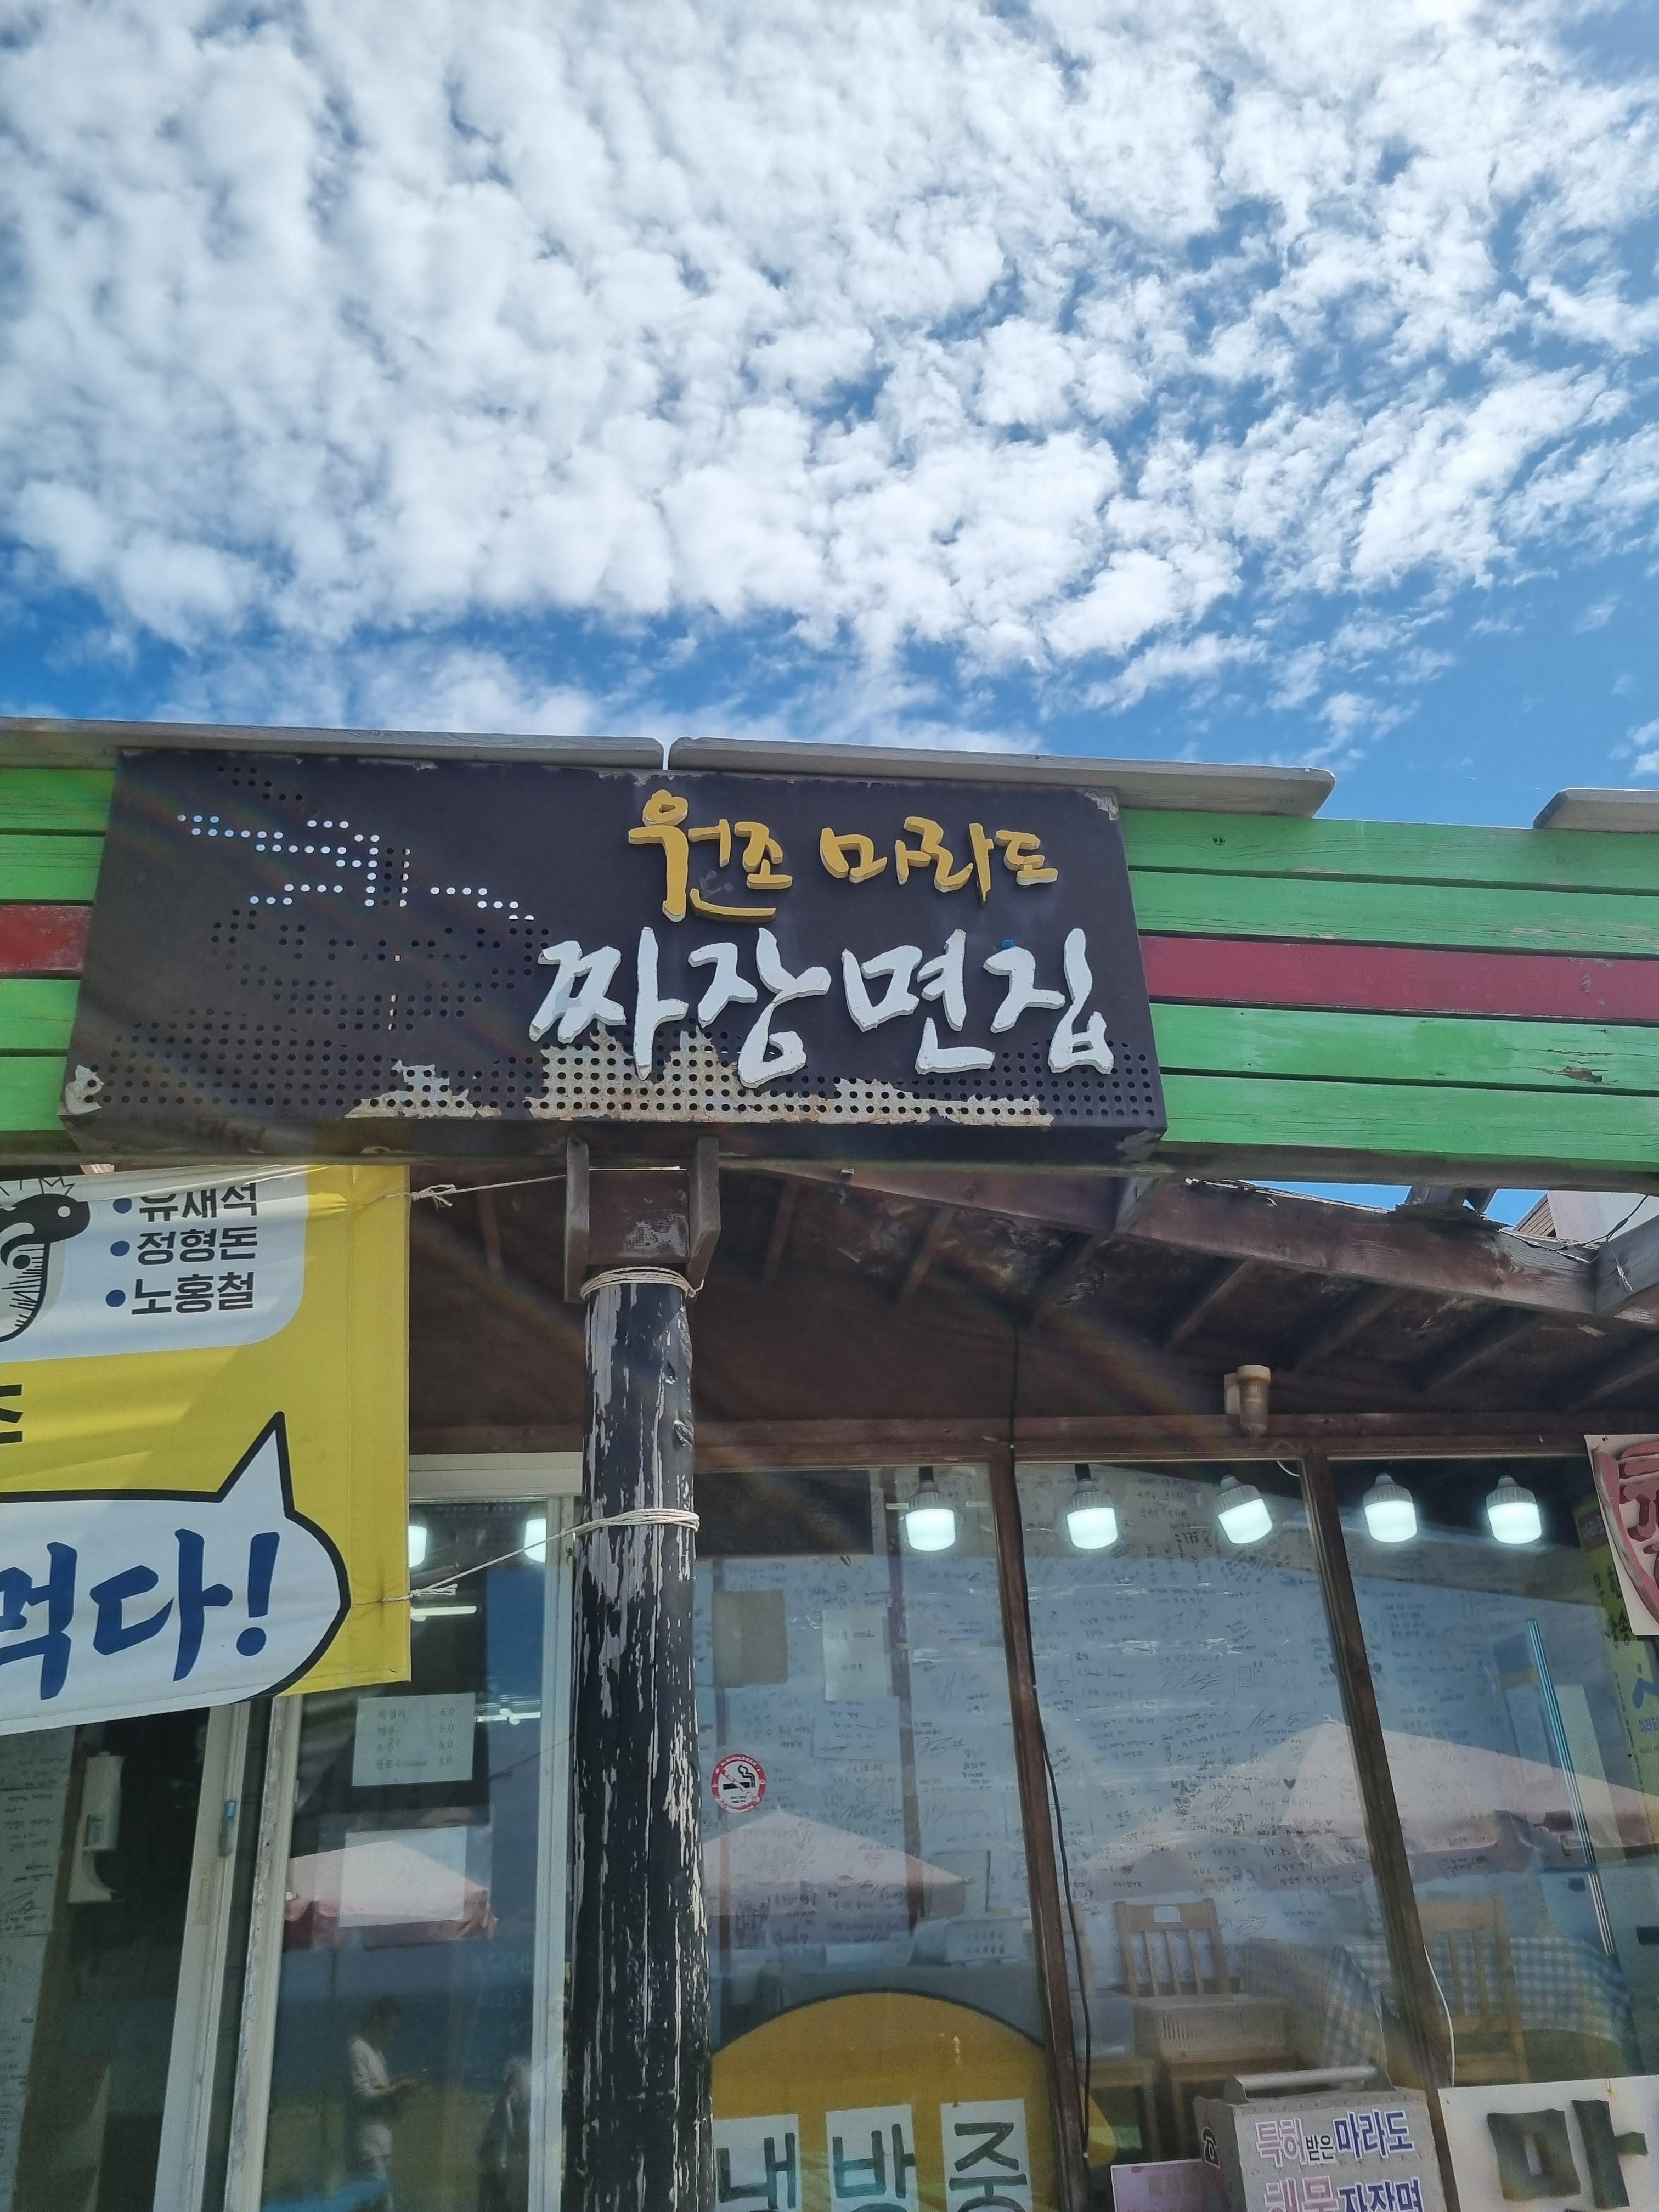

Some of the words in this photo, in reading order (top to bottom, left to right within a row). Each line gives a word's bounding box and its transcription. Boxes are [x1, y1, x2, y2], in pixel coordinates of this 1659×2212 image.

[628, 789, 793, 923] 원조
[820, 815, 1058, 905] 마라도
[529, 927, 1115, 1088] 짜장면집
[137, 1226, 258, 1266] 정형돈
[131, 1272, 255, 1316] 노홍철
[1255, 2118, 1308, 2168] 특허
[1306, 2134, 1335, 2162] 받은
[1333, 2109, 1415, 2162] 마라도
